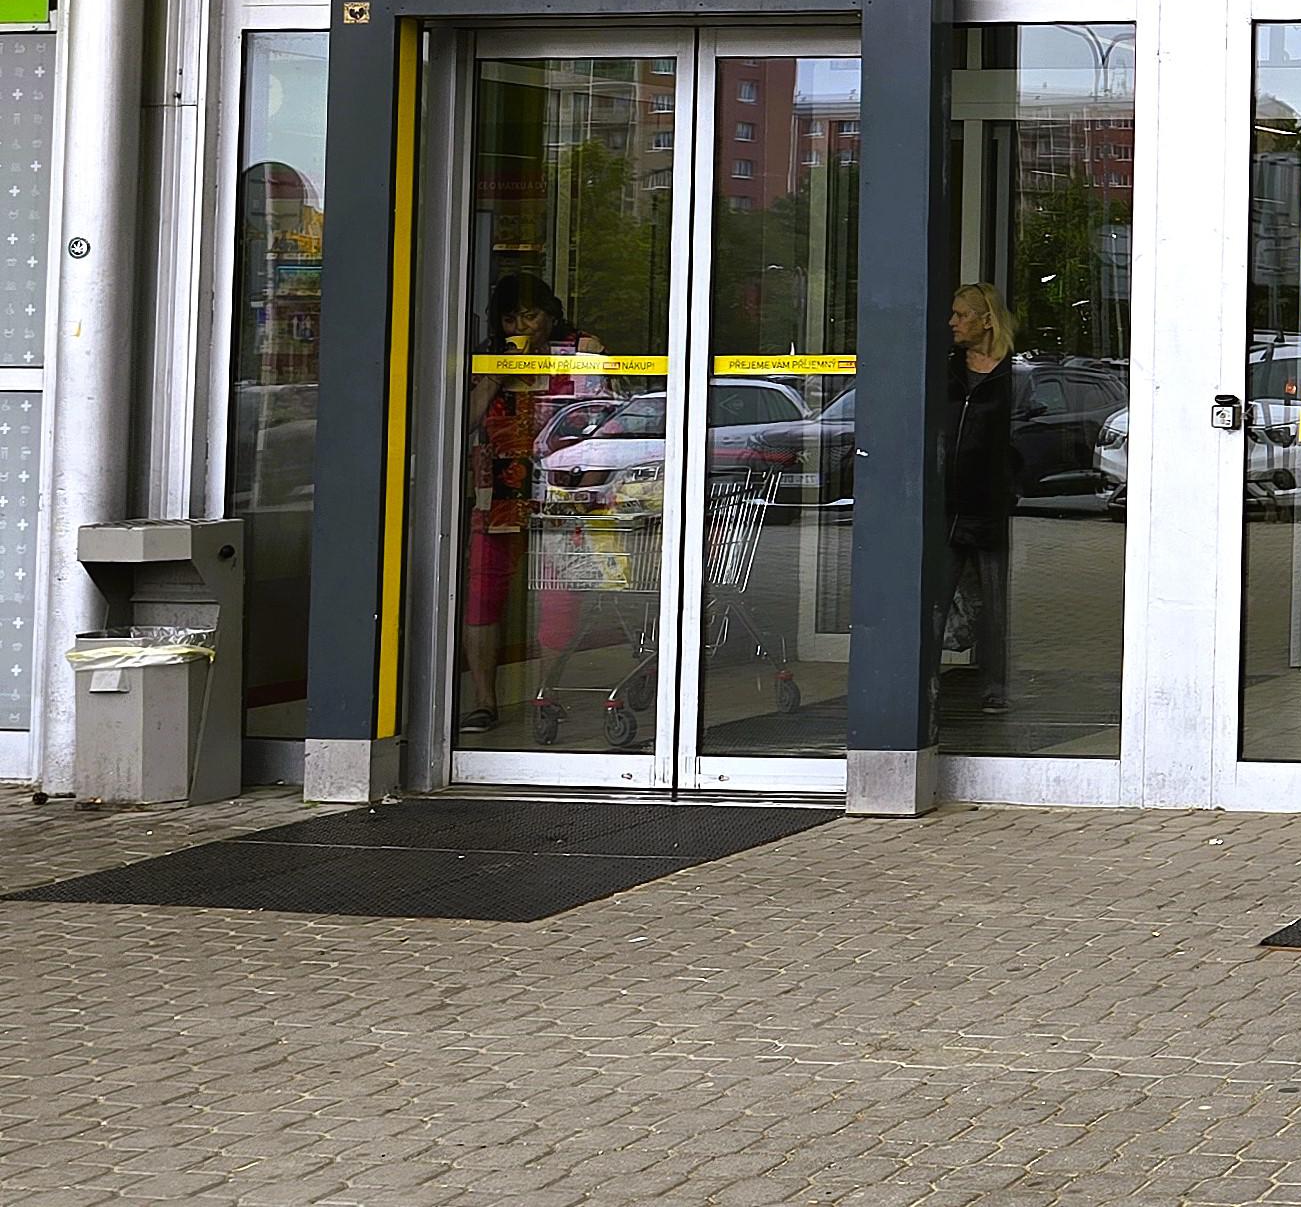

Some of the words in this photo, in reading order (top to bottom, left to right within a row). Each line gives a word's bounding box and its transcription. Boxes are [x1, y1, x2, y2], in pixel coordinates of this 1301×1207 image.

[496, 360, 537, 369] PŘEJEME
[538, 359, 556, 369] VÁM
[557, 359, 601, 369] PŘÍJEMNÝ
[622, 360, 655, 370] NÁKUP!
[729, 359, 770, 369] PŘEJEME
[771, 359, 790, 369] VÁM
[792, 359, 836, 369] PŘÍJEMNÝ
